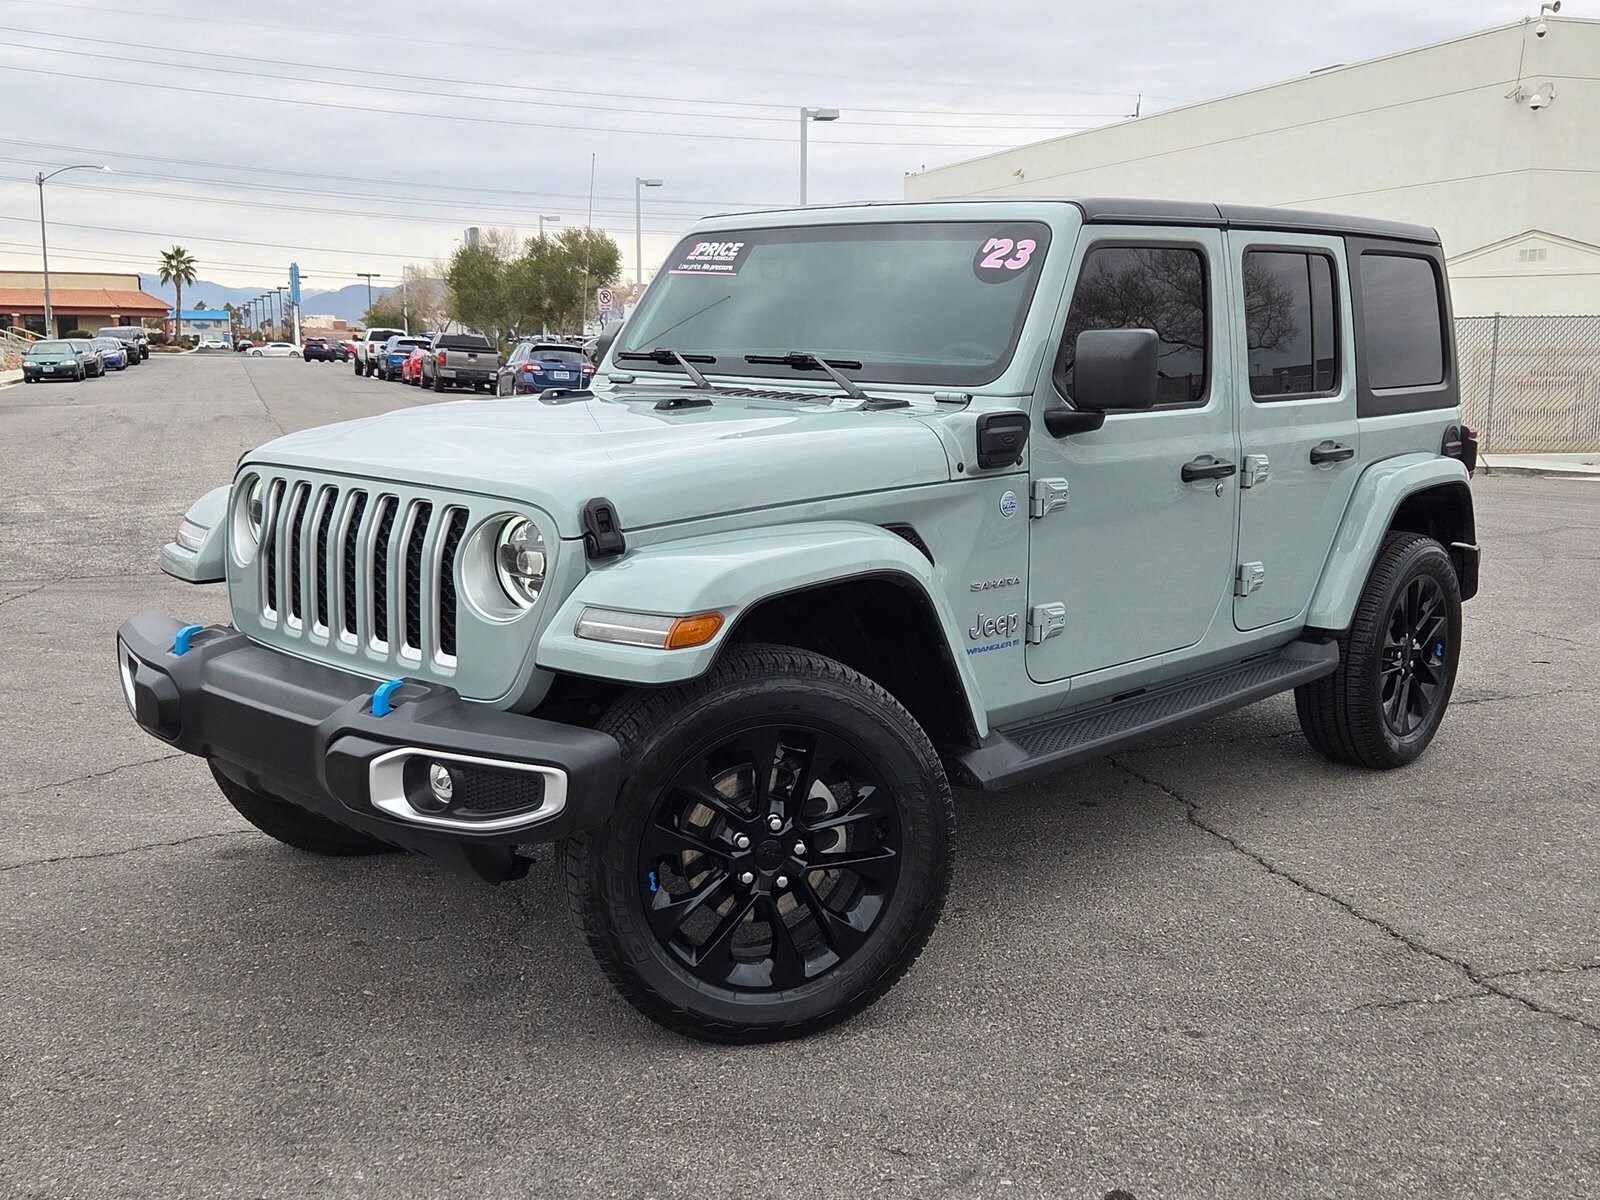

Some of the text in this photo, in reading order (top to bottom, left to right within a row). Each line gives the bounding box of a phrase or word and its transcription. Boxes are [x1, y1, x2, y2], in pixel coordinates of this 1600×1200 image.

[980, 238, 1036, 270] '23
[970, 576, 1020, 592] SAHARA
[969, 613, 1019, 640] Jeep
[966, 641, 1012, 655] WRANGLER
